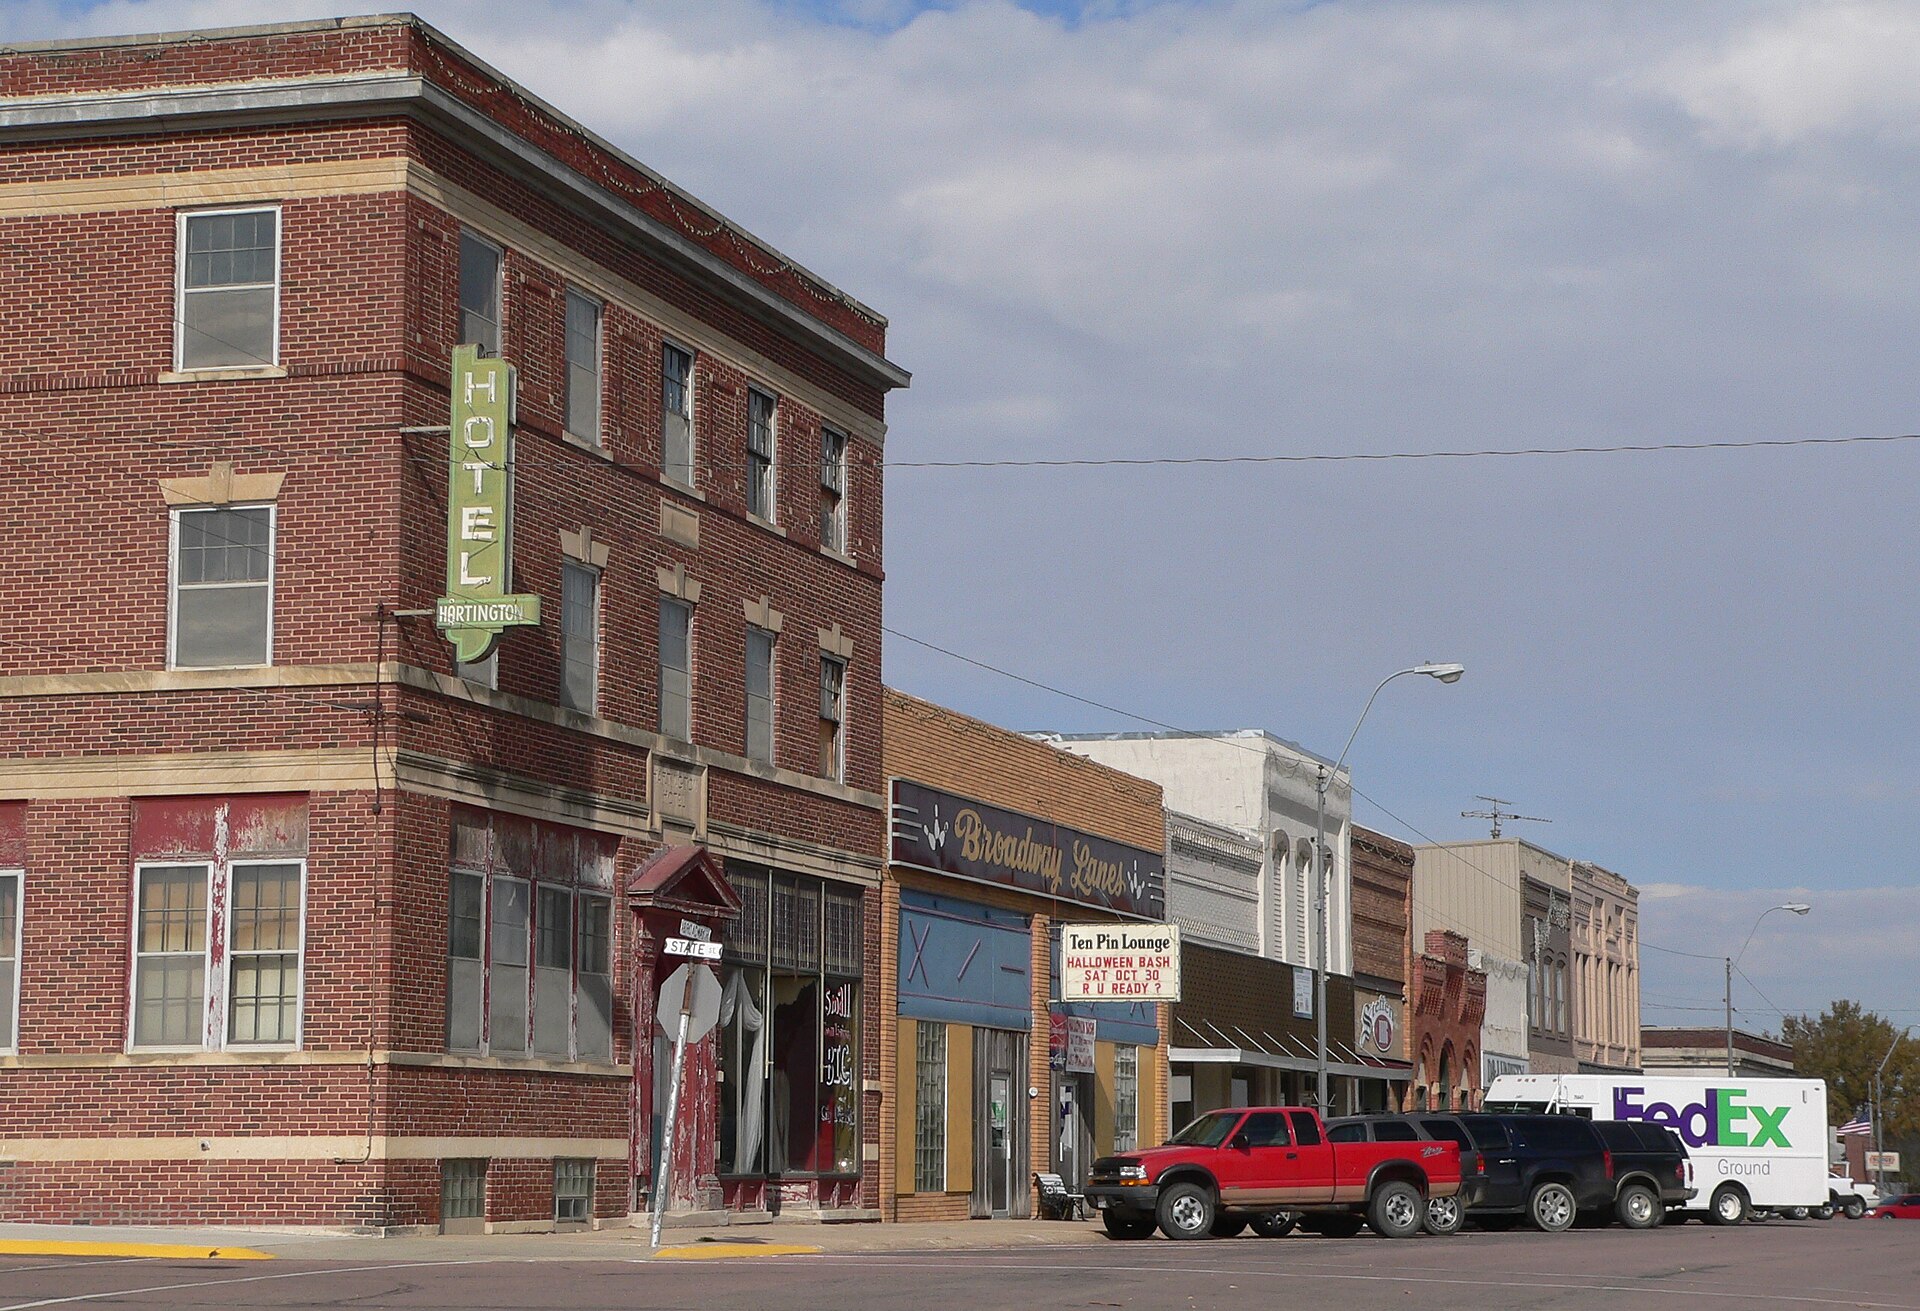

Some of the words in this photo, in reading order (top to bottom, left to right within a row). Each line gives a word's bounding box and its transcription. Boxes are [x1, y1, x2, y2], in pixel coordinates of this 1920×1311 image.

[460, 371, 497, 586] HOTEL
[439, 604, 523, 622] HARTINGTON
[954, 808, 1063, 893] Broadway
[1070, 839, 1127, 897] Lanes
[670, 941, 706, 955] STATE
[1069, 934, 1093, 949] Ten
[1096, 934, 1119, 949] Pin
[1121, 934, 1170, 953] Lounge
[1067, 956, 1133, 968] HALLOWEEN
[1138, 956, 1170, 968] BASH
[1084, 970, 1108, 981] SAT
[1115, 970, 1138, 981] OCT
[1145, 969, 1159, 981] 30
[1082, 983, 1090, 994] R
[1097, 983, 1104, 994] U
[1111, 983, 1149, 994] READY
[1154, 983, 1162, 994] ?
[1612, 1086, 1793, 1148] FedEx
[1717, 1158, 1770, 1175] Ground
